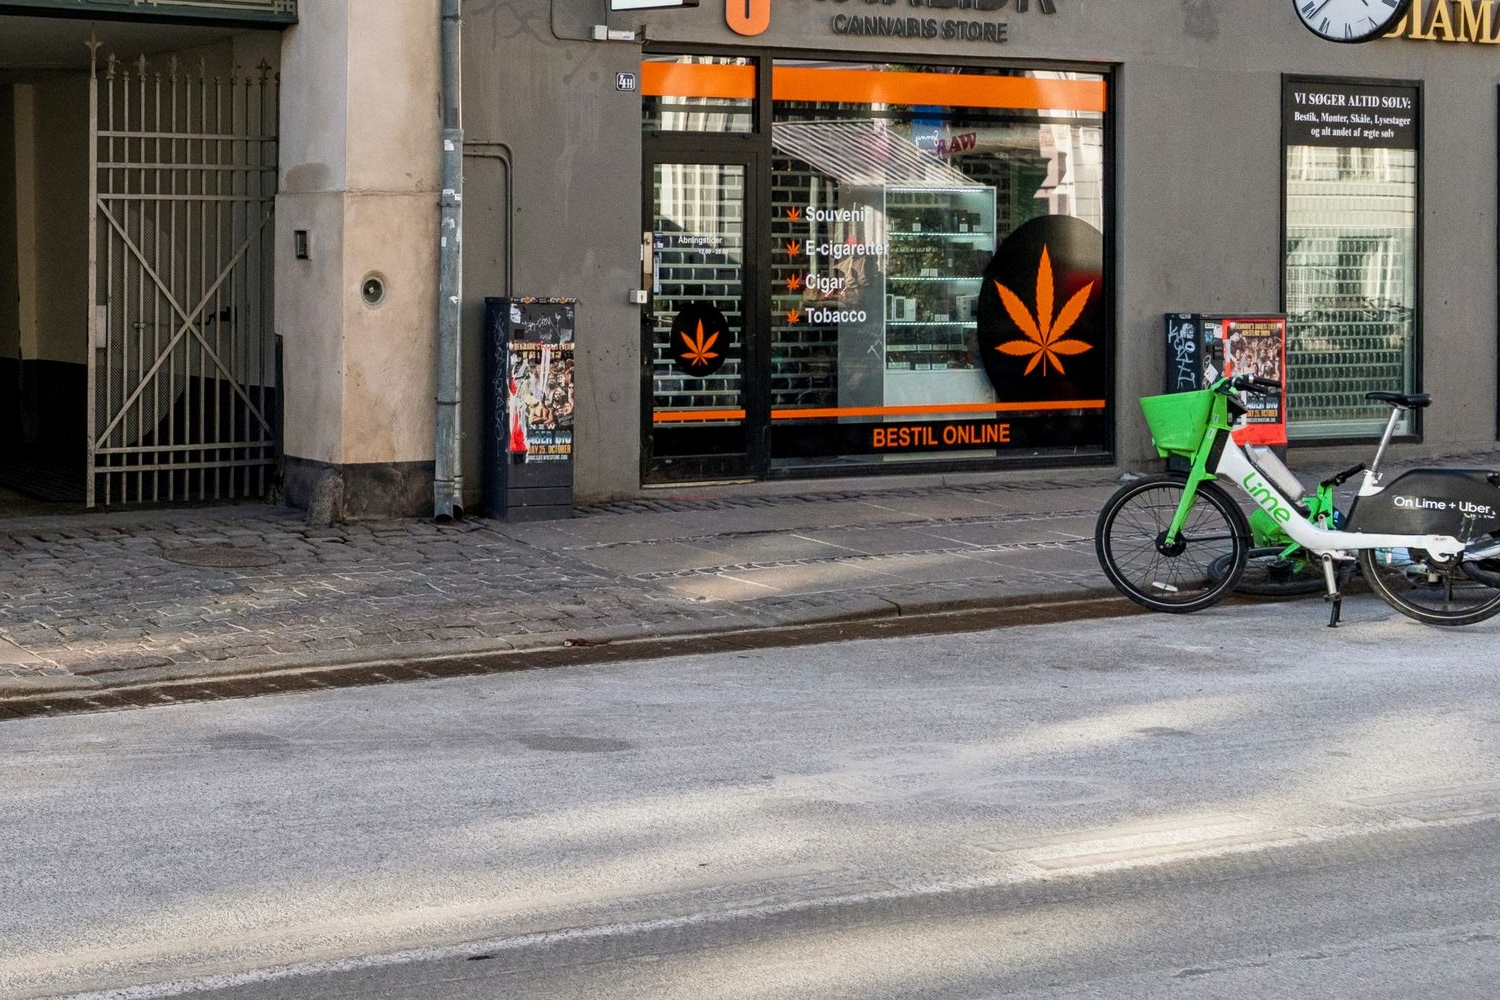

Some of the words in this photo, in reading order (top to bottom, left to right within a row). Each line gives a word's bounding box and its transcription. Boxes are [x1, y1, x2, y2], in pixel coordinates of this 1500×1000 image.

[832, 13, 938, 39] CANNABIS
[942, 19, 1009, 43] STORE
[1294, 92, 1306, 105] VI
[1308, 93, 1346, 106] SØGER
[1348, 94, 1380, 107] ALTID
[1382, 96, 1411, 109] SØLV:
[1294, 111, 1319, 123] Bestik,
[1350, 113, 1373, 125] Skåle,
[1374, 114, 1411, 127] Lysestager
[1310, 128, 1320, 138] og
[1321, 126, 1331, 136] alt
[1332, 127, 1352, 137] andet
[1353, 127, 1362, 137] af
[1363, 129, 1380, 139] ægte
[805, 205, 871, 222] Souvenir
[805, 239, 890, 260] E-cigaretter
[805, 273, 845, 293] Cigar
[804, 307, 867, 323] Tobacco
[872, 426, 938, 448] BESTIL
[943, 423, 1011, 445] ONLINE
[1242, 471, 1291, 523] Lime
[1393, 496, 1413, 508] On
[1415, 497, 1446, 510] Lime
[1458, 501, 1491, 514] Uber
